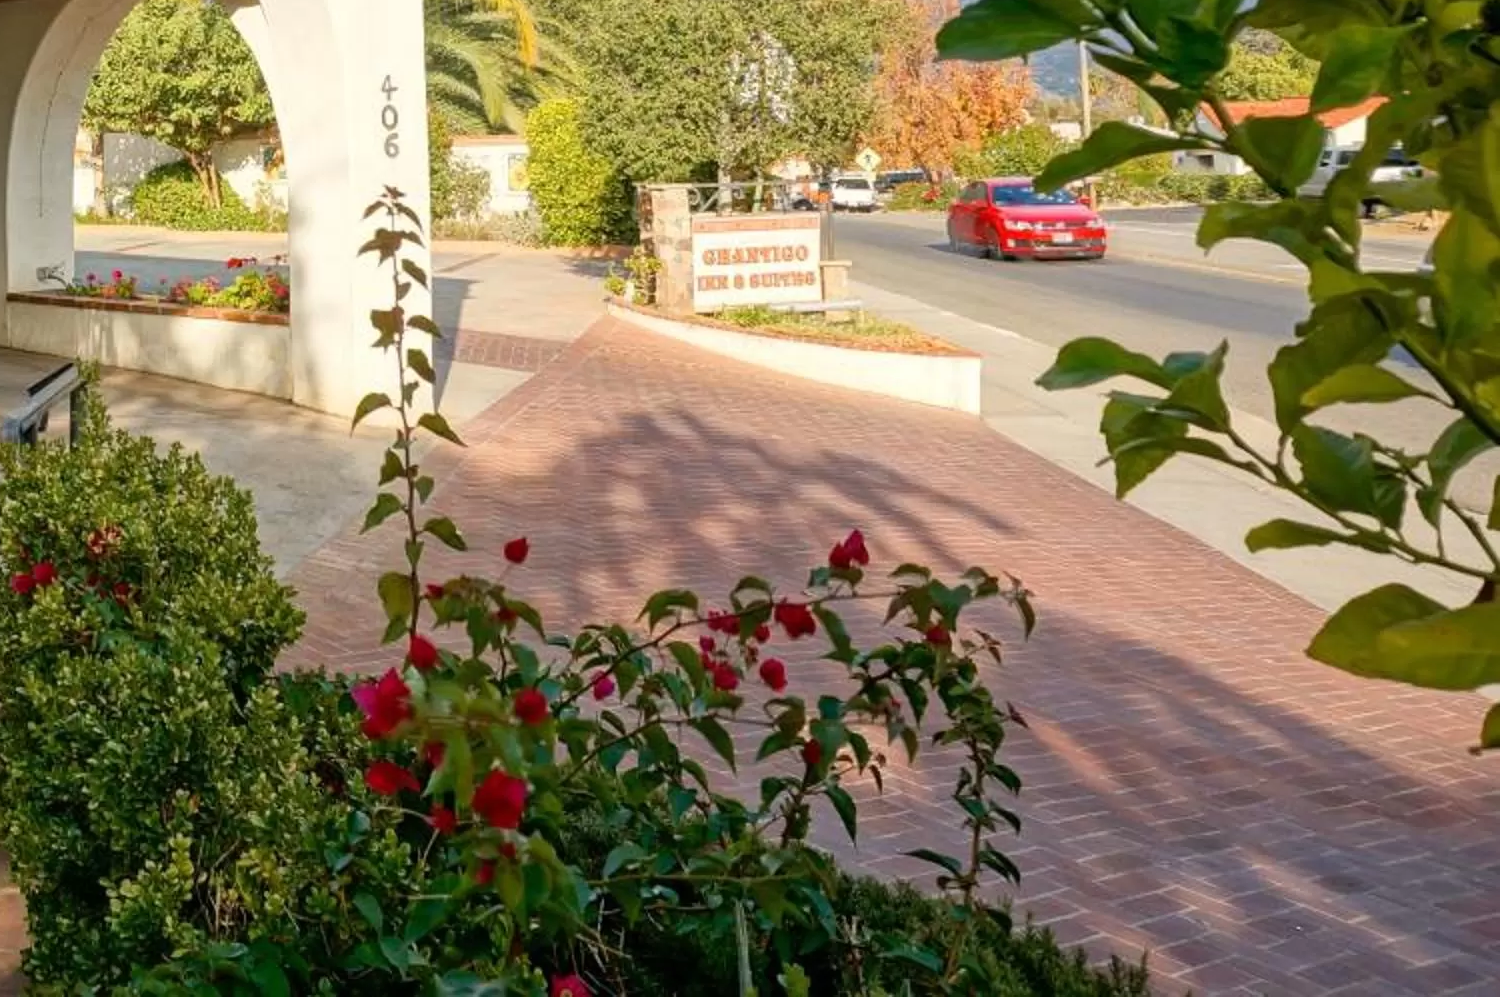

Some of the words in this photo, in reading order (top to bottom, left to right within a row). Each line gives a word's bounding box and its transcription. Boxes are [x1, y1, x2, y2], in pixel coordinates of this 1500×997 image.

[381, 74, 399, 159] 406
[698, 275, 728, 291] INN
[750, 271, 816, 289] SUITES
